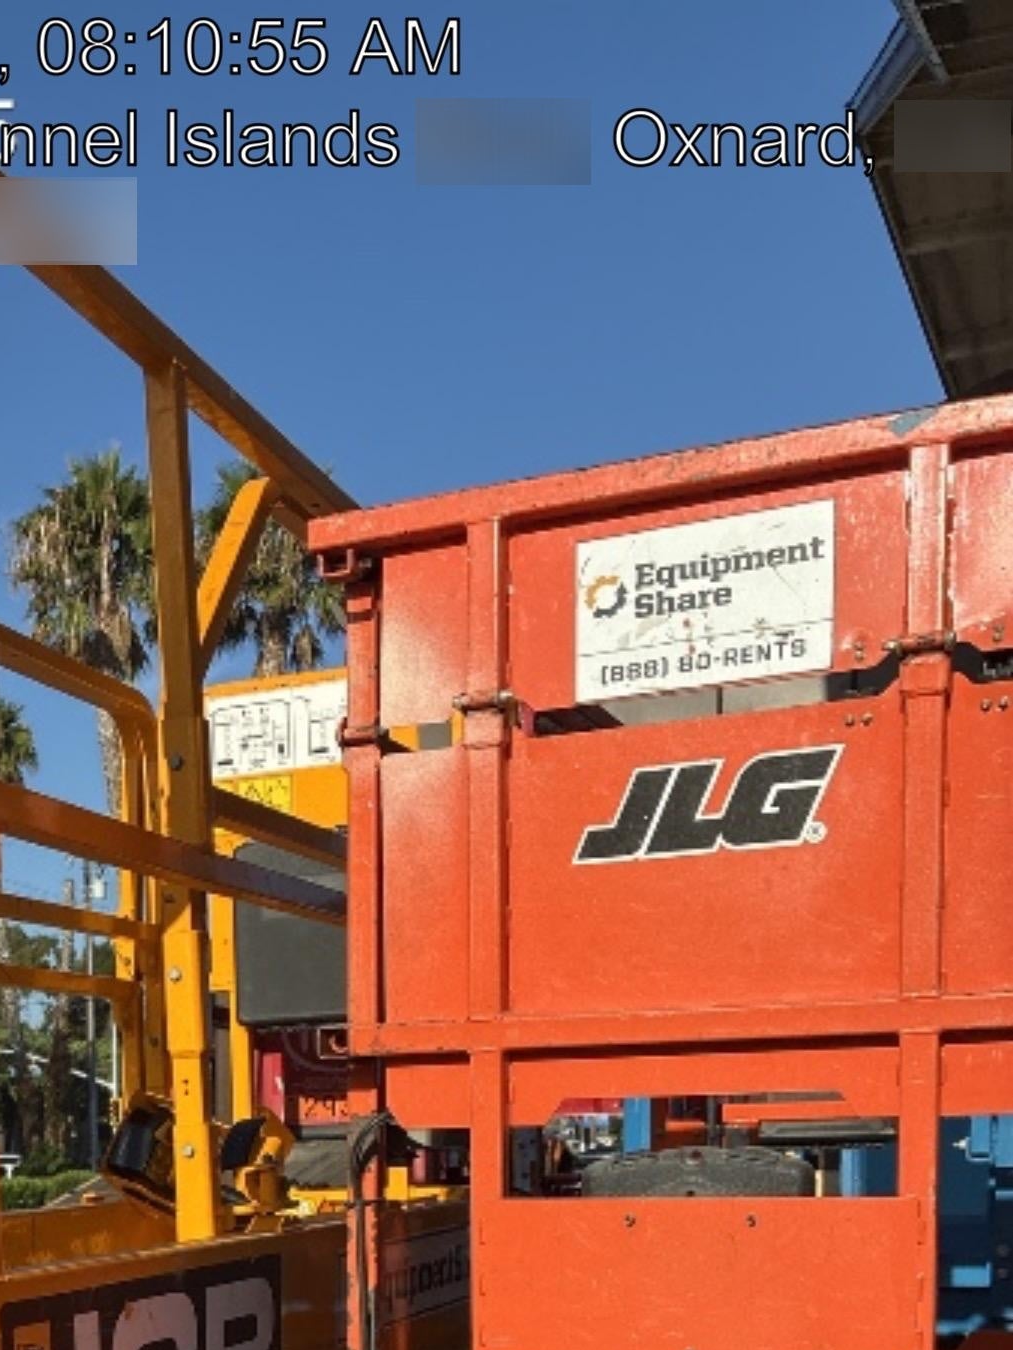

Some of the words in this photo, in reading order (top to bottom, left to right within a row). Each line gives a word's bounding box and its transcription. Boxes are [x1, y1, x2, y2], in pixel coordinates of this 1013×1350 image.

[634, 536, 826, 590] Equipment
[634, 586, 733, 619] Share
[600, 657, 669, 685] (888)
[678, 638, 808, 674] 80-RENTS
[573, 744, 846, 865] JLG
